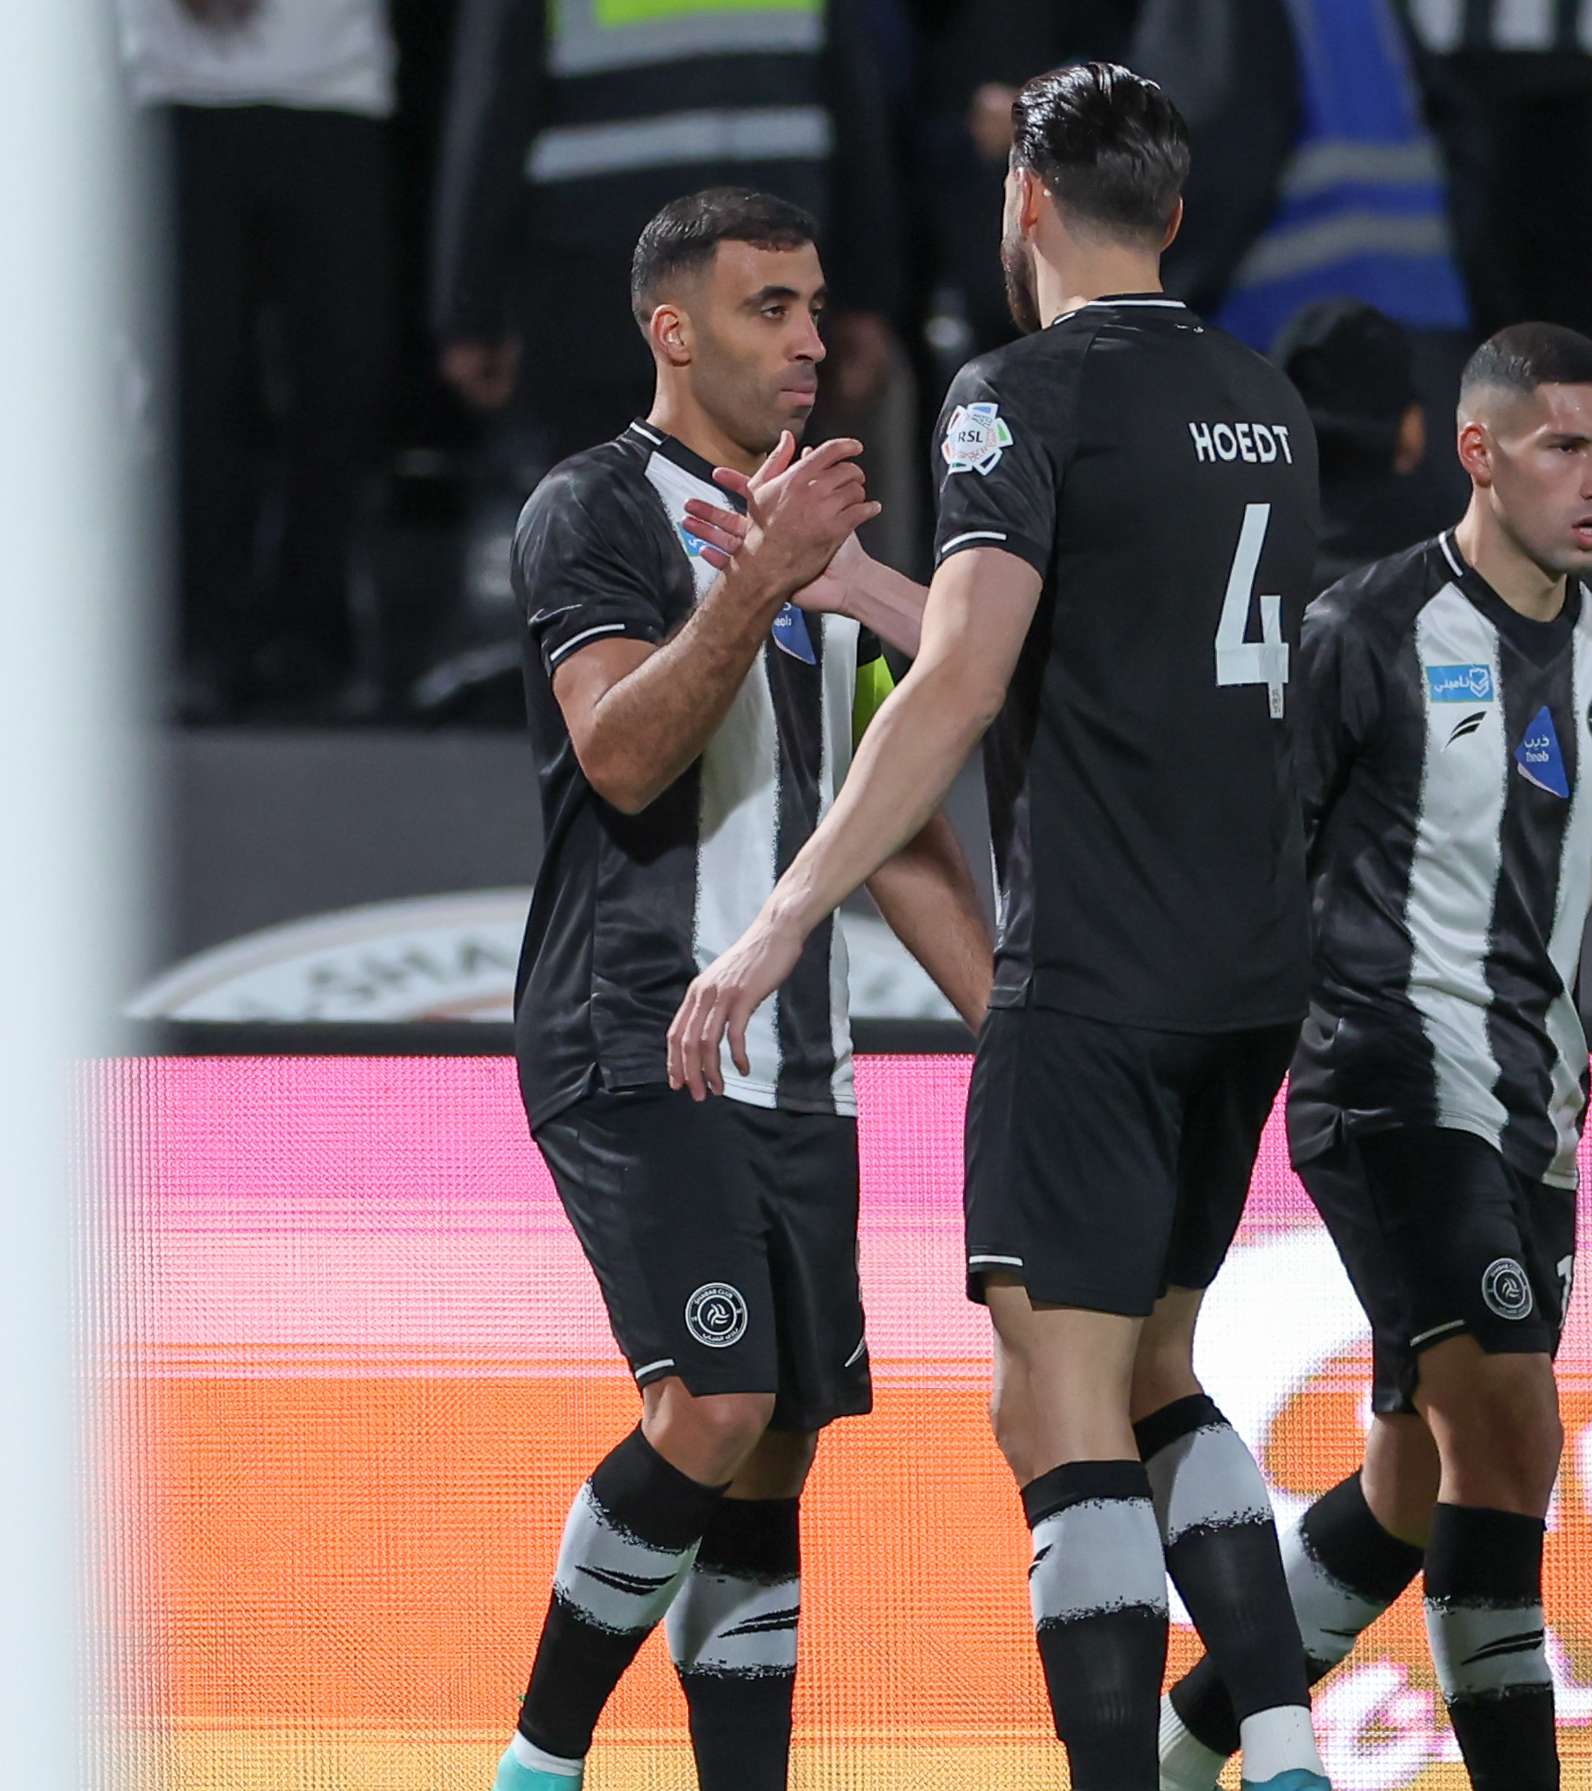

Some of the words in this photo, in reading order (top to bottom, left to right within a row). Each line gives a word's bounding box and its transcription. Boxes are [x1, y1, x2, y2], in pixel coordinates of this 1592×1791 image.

[958, 430, 983, 443] RSL
[1188, 421, 1293, 464] HOEDT
[1215, 503, 1289, 719] 4
